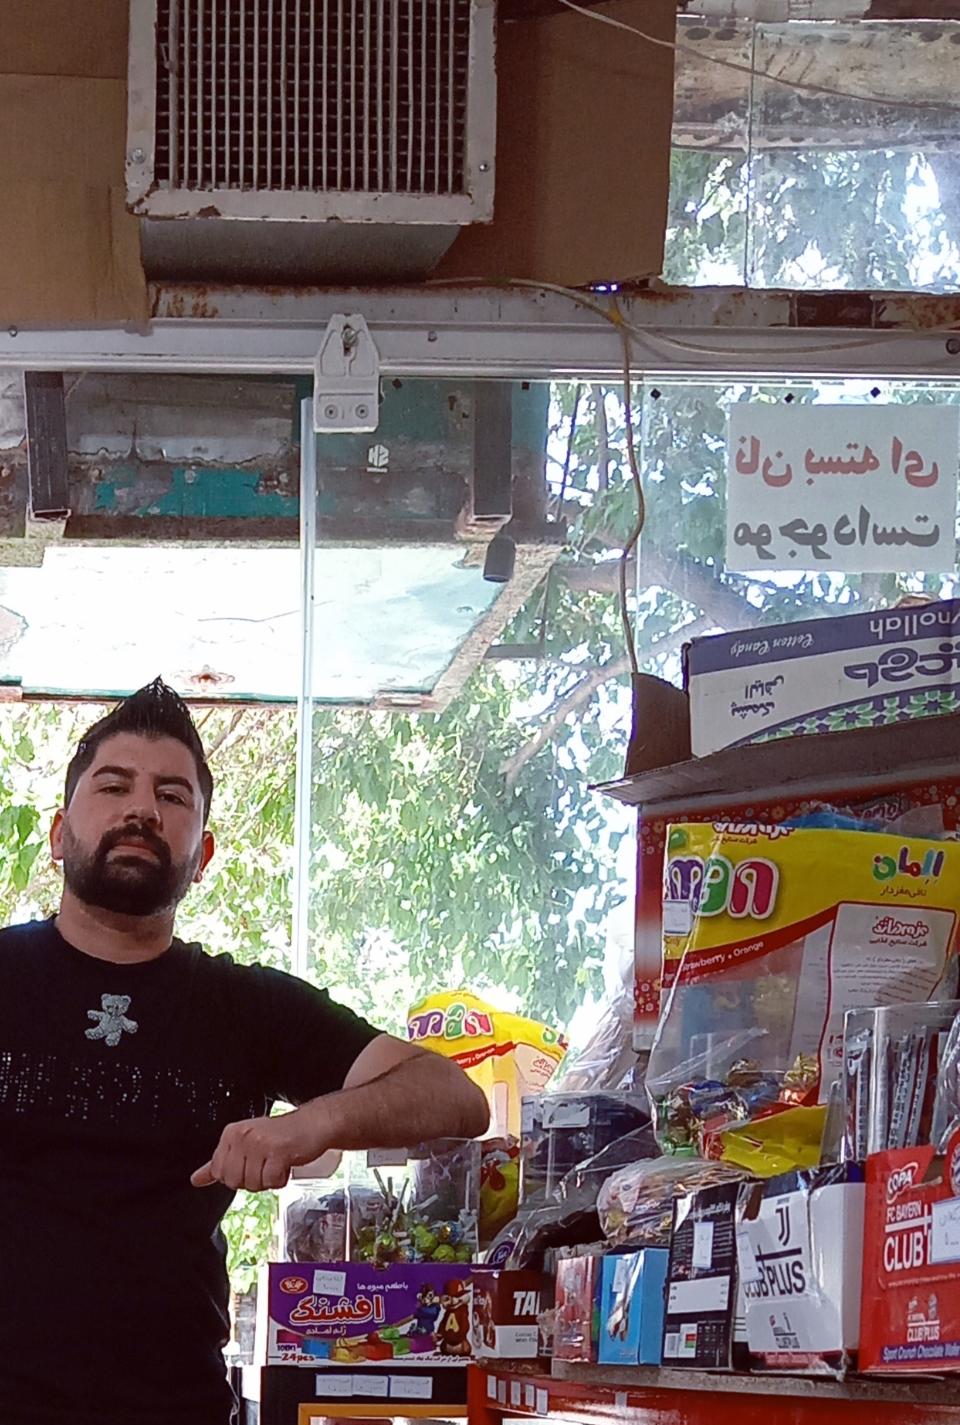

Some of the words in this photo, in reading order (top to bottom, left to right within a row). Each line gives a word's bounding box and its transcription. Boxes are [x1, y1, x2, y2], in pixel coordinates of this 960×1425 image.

[730, 639, 769, 657] Candy
[772, 633, 814, 649] Cotton
[730, 700, 775, 719] پشمک
[733, 941, 764, 957] Orange
[886, 1168, 914, 1197] COPA
[895, 1200, 922, 1221] BAYERN
[883, 1231, 924, 1272] CLUB
[769, 1259, 806, 1296] PLUS
[513, 1290, 540, 1316] TA
